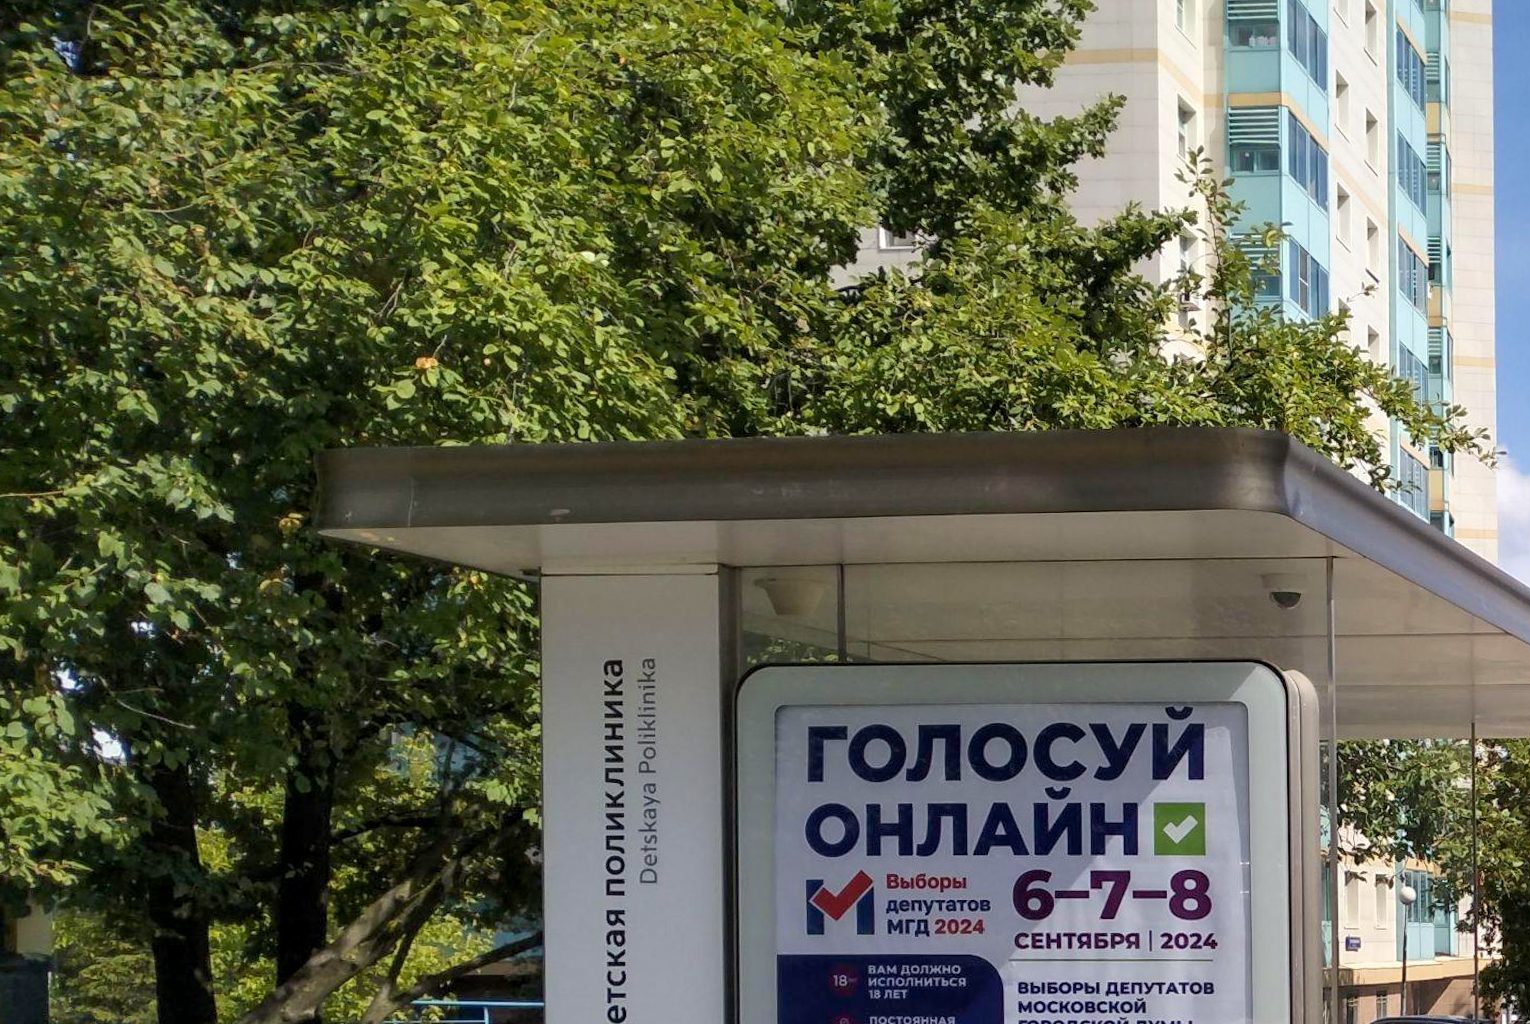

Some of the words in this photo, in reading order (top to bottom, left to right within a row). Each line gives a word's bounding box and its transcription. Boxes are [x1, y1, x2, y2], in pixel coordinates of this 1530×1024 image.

[638, 658, 657, 774] Poliklinika
[807, 706, 1205, 782] ГОЛОСУЙ
[603, 660, 625, 896] поликлиника
[804, 786, 1138, 858] ОНЛАЙН
[639, 782, 661, 884] Detskaya
[886, 874, 967, 892] Выборы
[886, 900, 991, 915] депутатов
[887, 919, 929, 936] МГД
[935, 919, 985, 934] 2024
[1014, 933, 1140, 949] СЕНТЯБРЯ
[1160, 933, 1217, 949] 2024
[868, 965, 897, 974] ВАМ
[900, 965, 961, 975] ДОЛЖНО
[833, 975, 848, 986] 18
[868, 978, 966, 987] ИСПОЛНИТЬСЯ
[869, 990, 880, 998] 18
[884, 990, 908, 998] ЛЕТ
[1018, 982, 1099, 994] ВЫБОРЫ
[1106, 982, 1214, 996] ДЕПУТАТОВ
[1018, 998, 1146, 1013] МОСКОВСКОЙ
[870, 1017, 955, 1024] ПОСТОЯННАЯ
